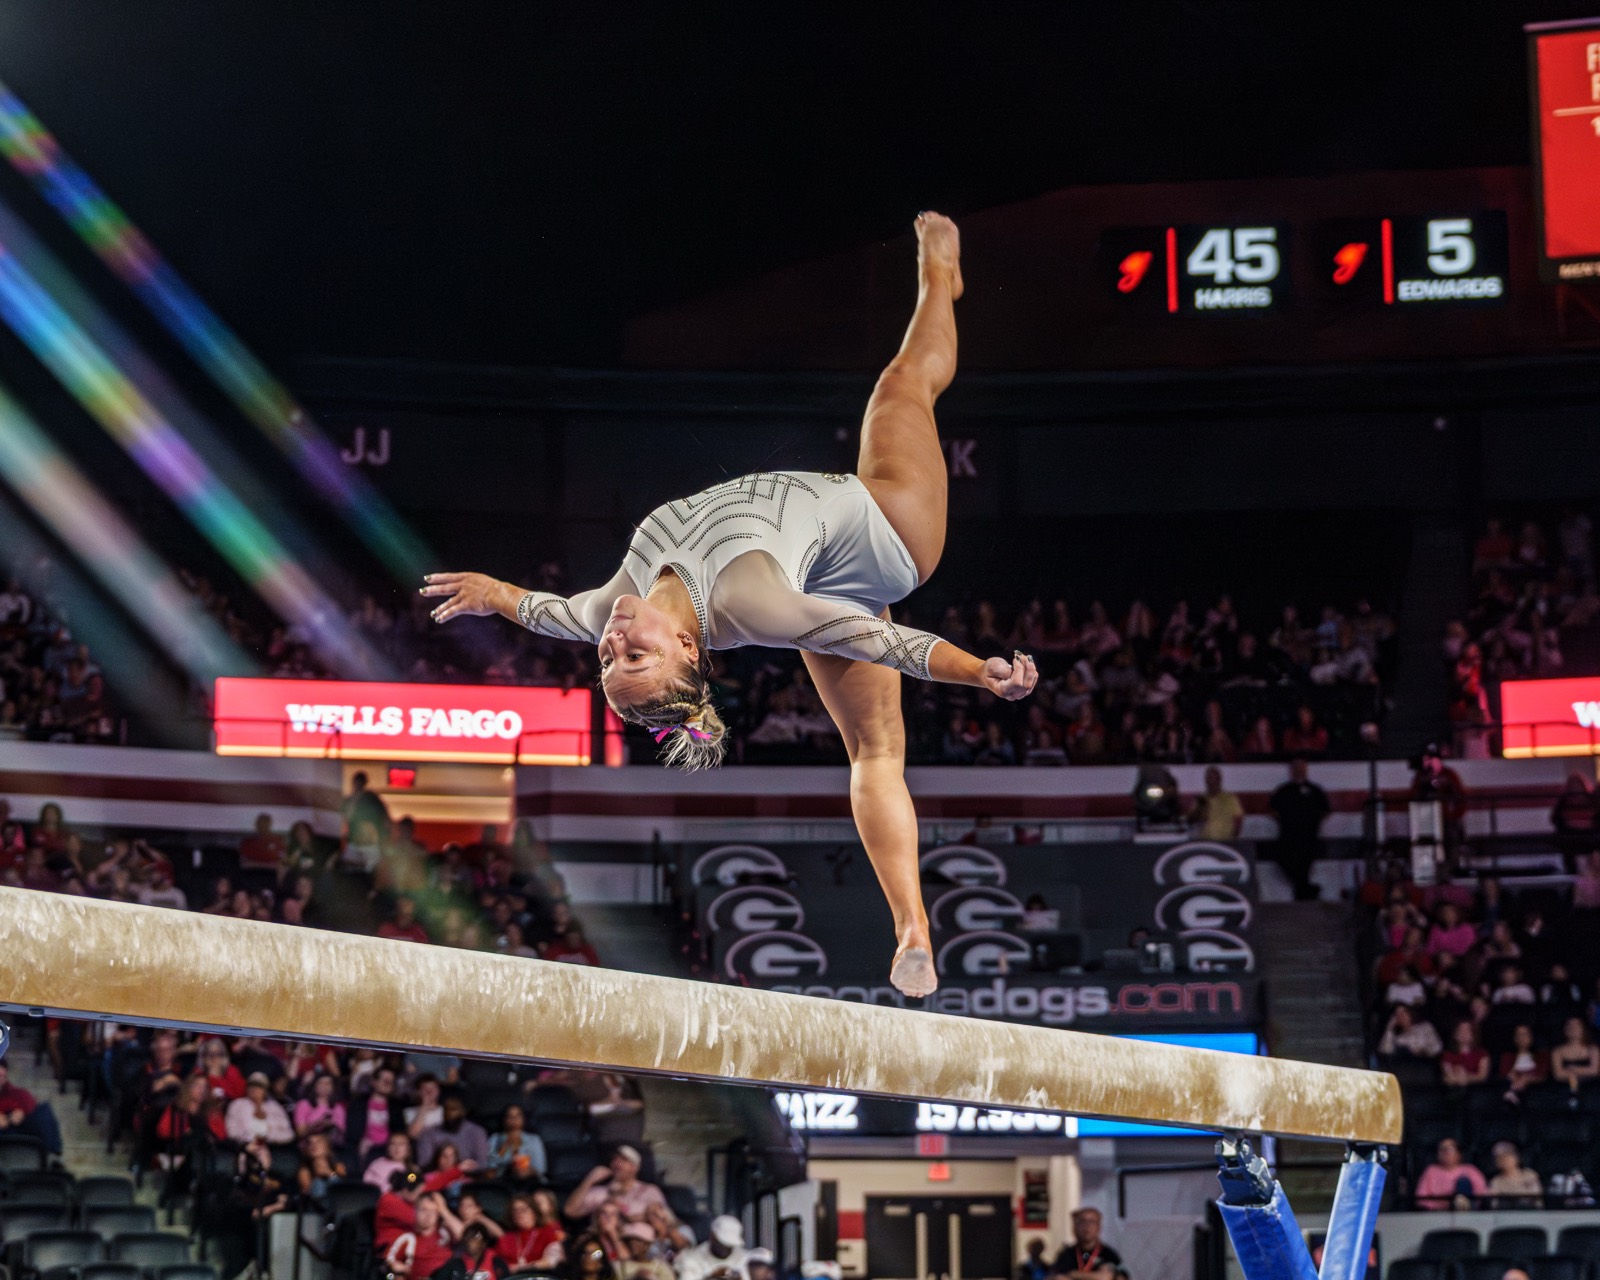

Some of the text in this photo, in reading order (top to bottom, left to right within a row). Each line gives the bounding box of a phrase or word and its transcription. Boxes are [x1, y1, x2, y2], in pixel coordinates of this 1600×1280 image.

[1187, 227, 1280, 284] 45
[1427, 218, 1476, 275] 5
[1194, 286, 1272, 309] HARRIS
[1398, 276, 1503, 301] EDWARDS
[340, 427, 389, 465] JJ
[285, 704, 523, 739] WELLS FARGO
